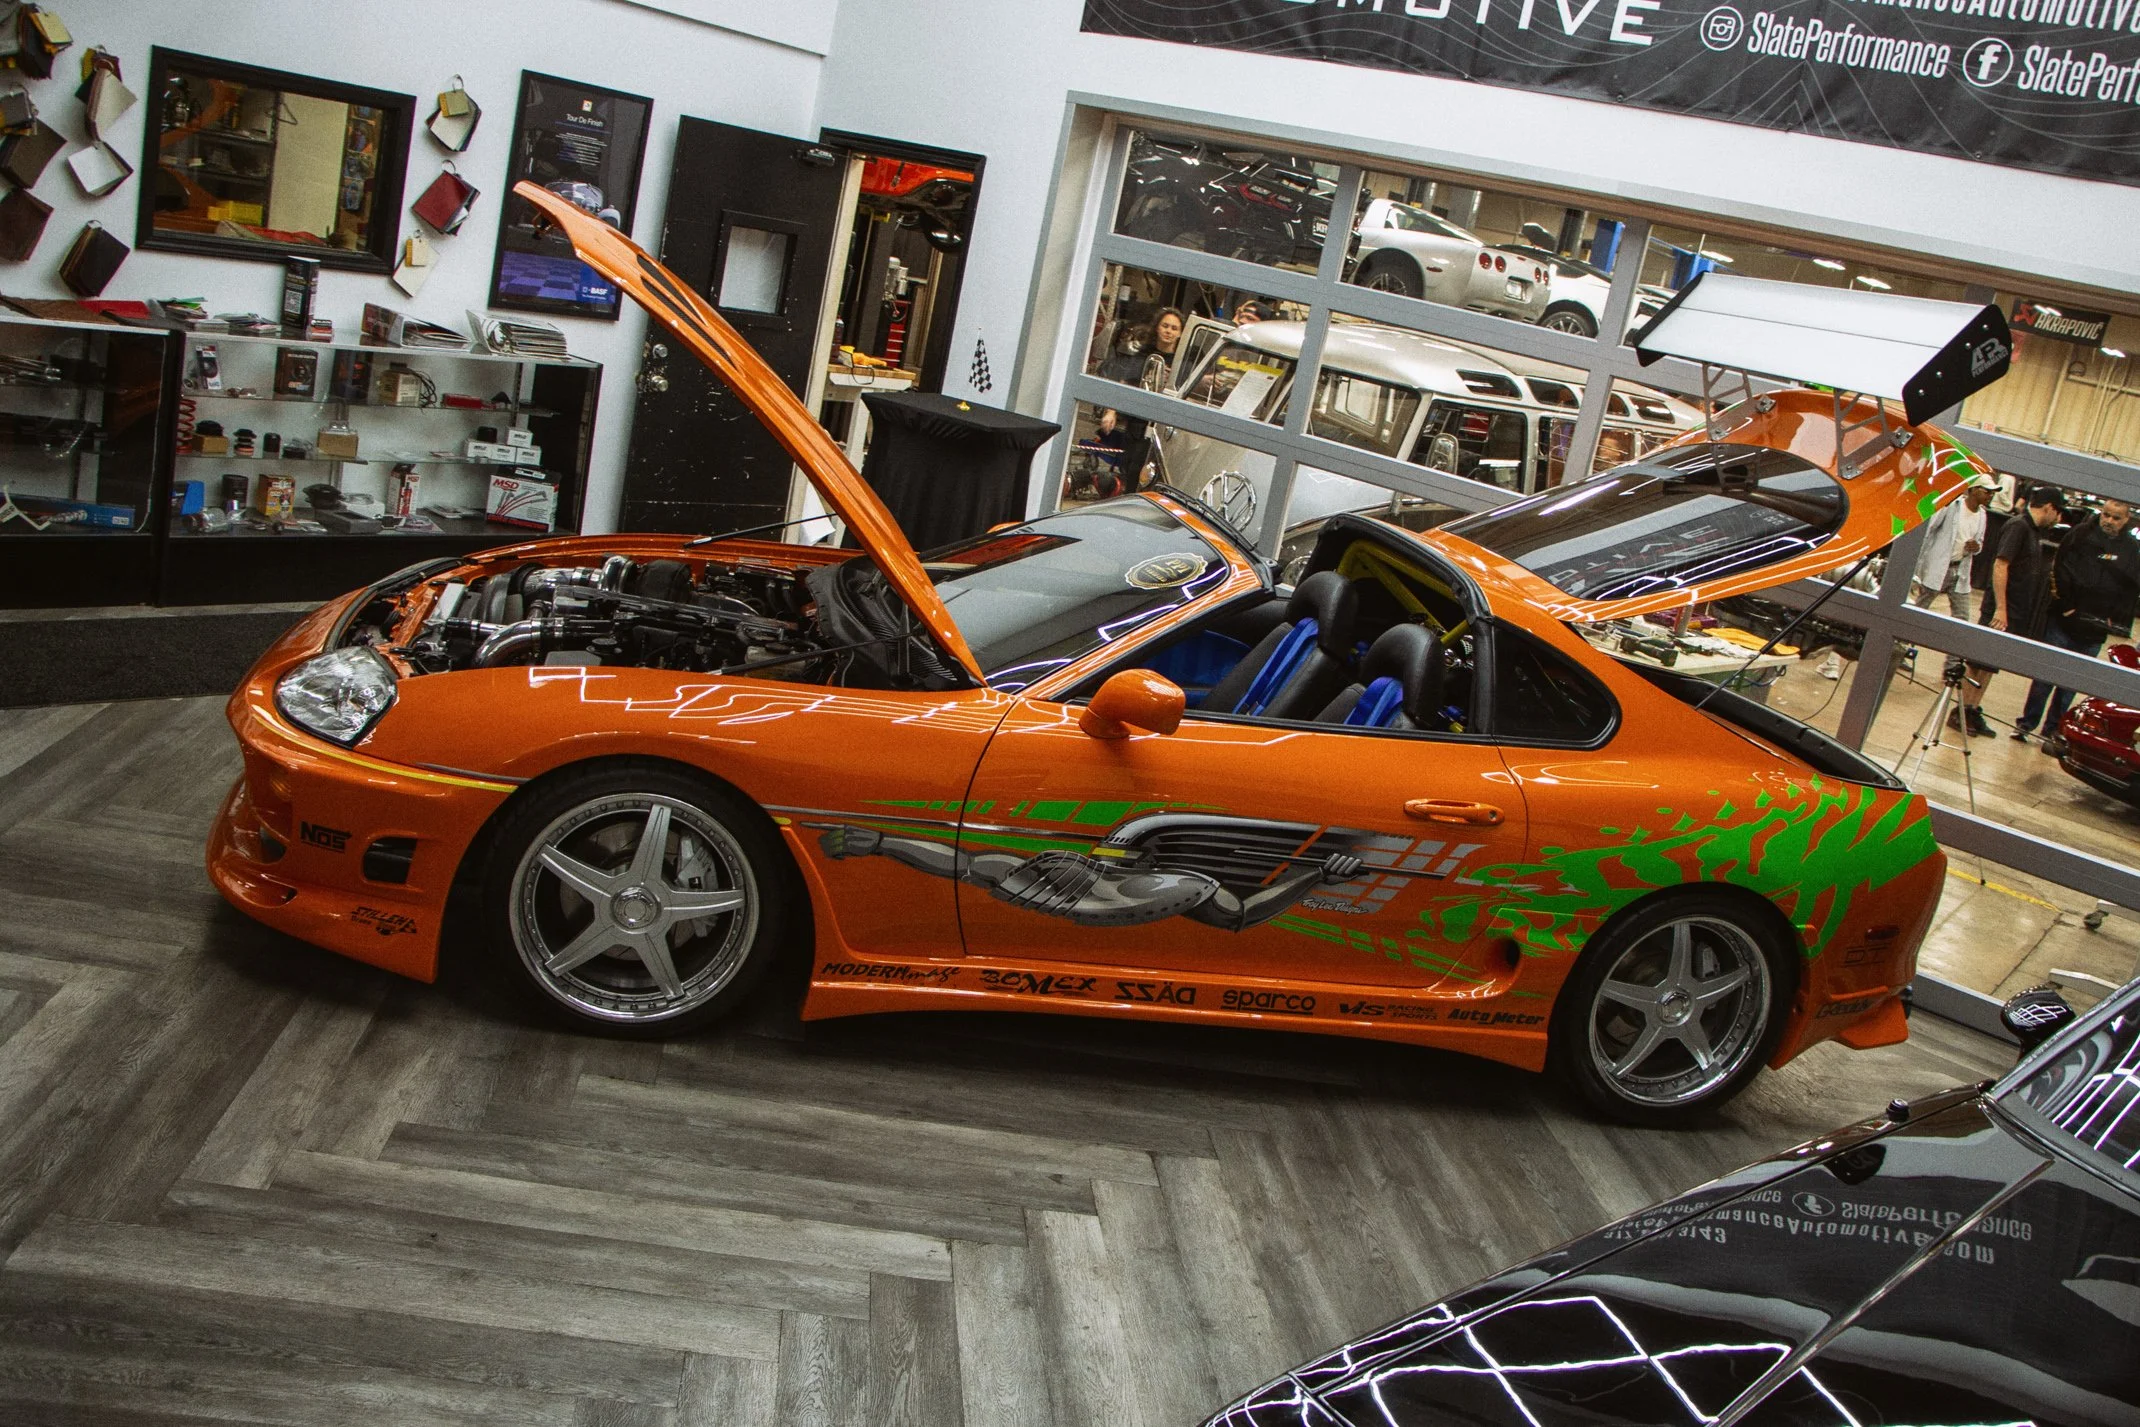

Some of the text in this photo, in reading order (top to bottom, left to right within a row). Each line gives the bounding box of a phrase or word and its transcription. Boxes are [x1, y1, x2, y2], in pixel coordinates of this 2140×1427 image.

[1746, 11, 1951, 79] SlatePerformance
[2017, 44, 2140, 105] SlatePerf
[566, 113, 604, 127] Tour De Finish
[590, 287, 608, 295] BASF
[492, 478, 520, 491] MSD
[301, 821, 352, 850] NOS
[980, 969, 1098, 995] BOMEX
[1223, 986, 1316, 1013] sparco
